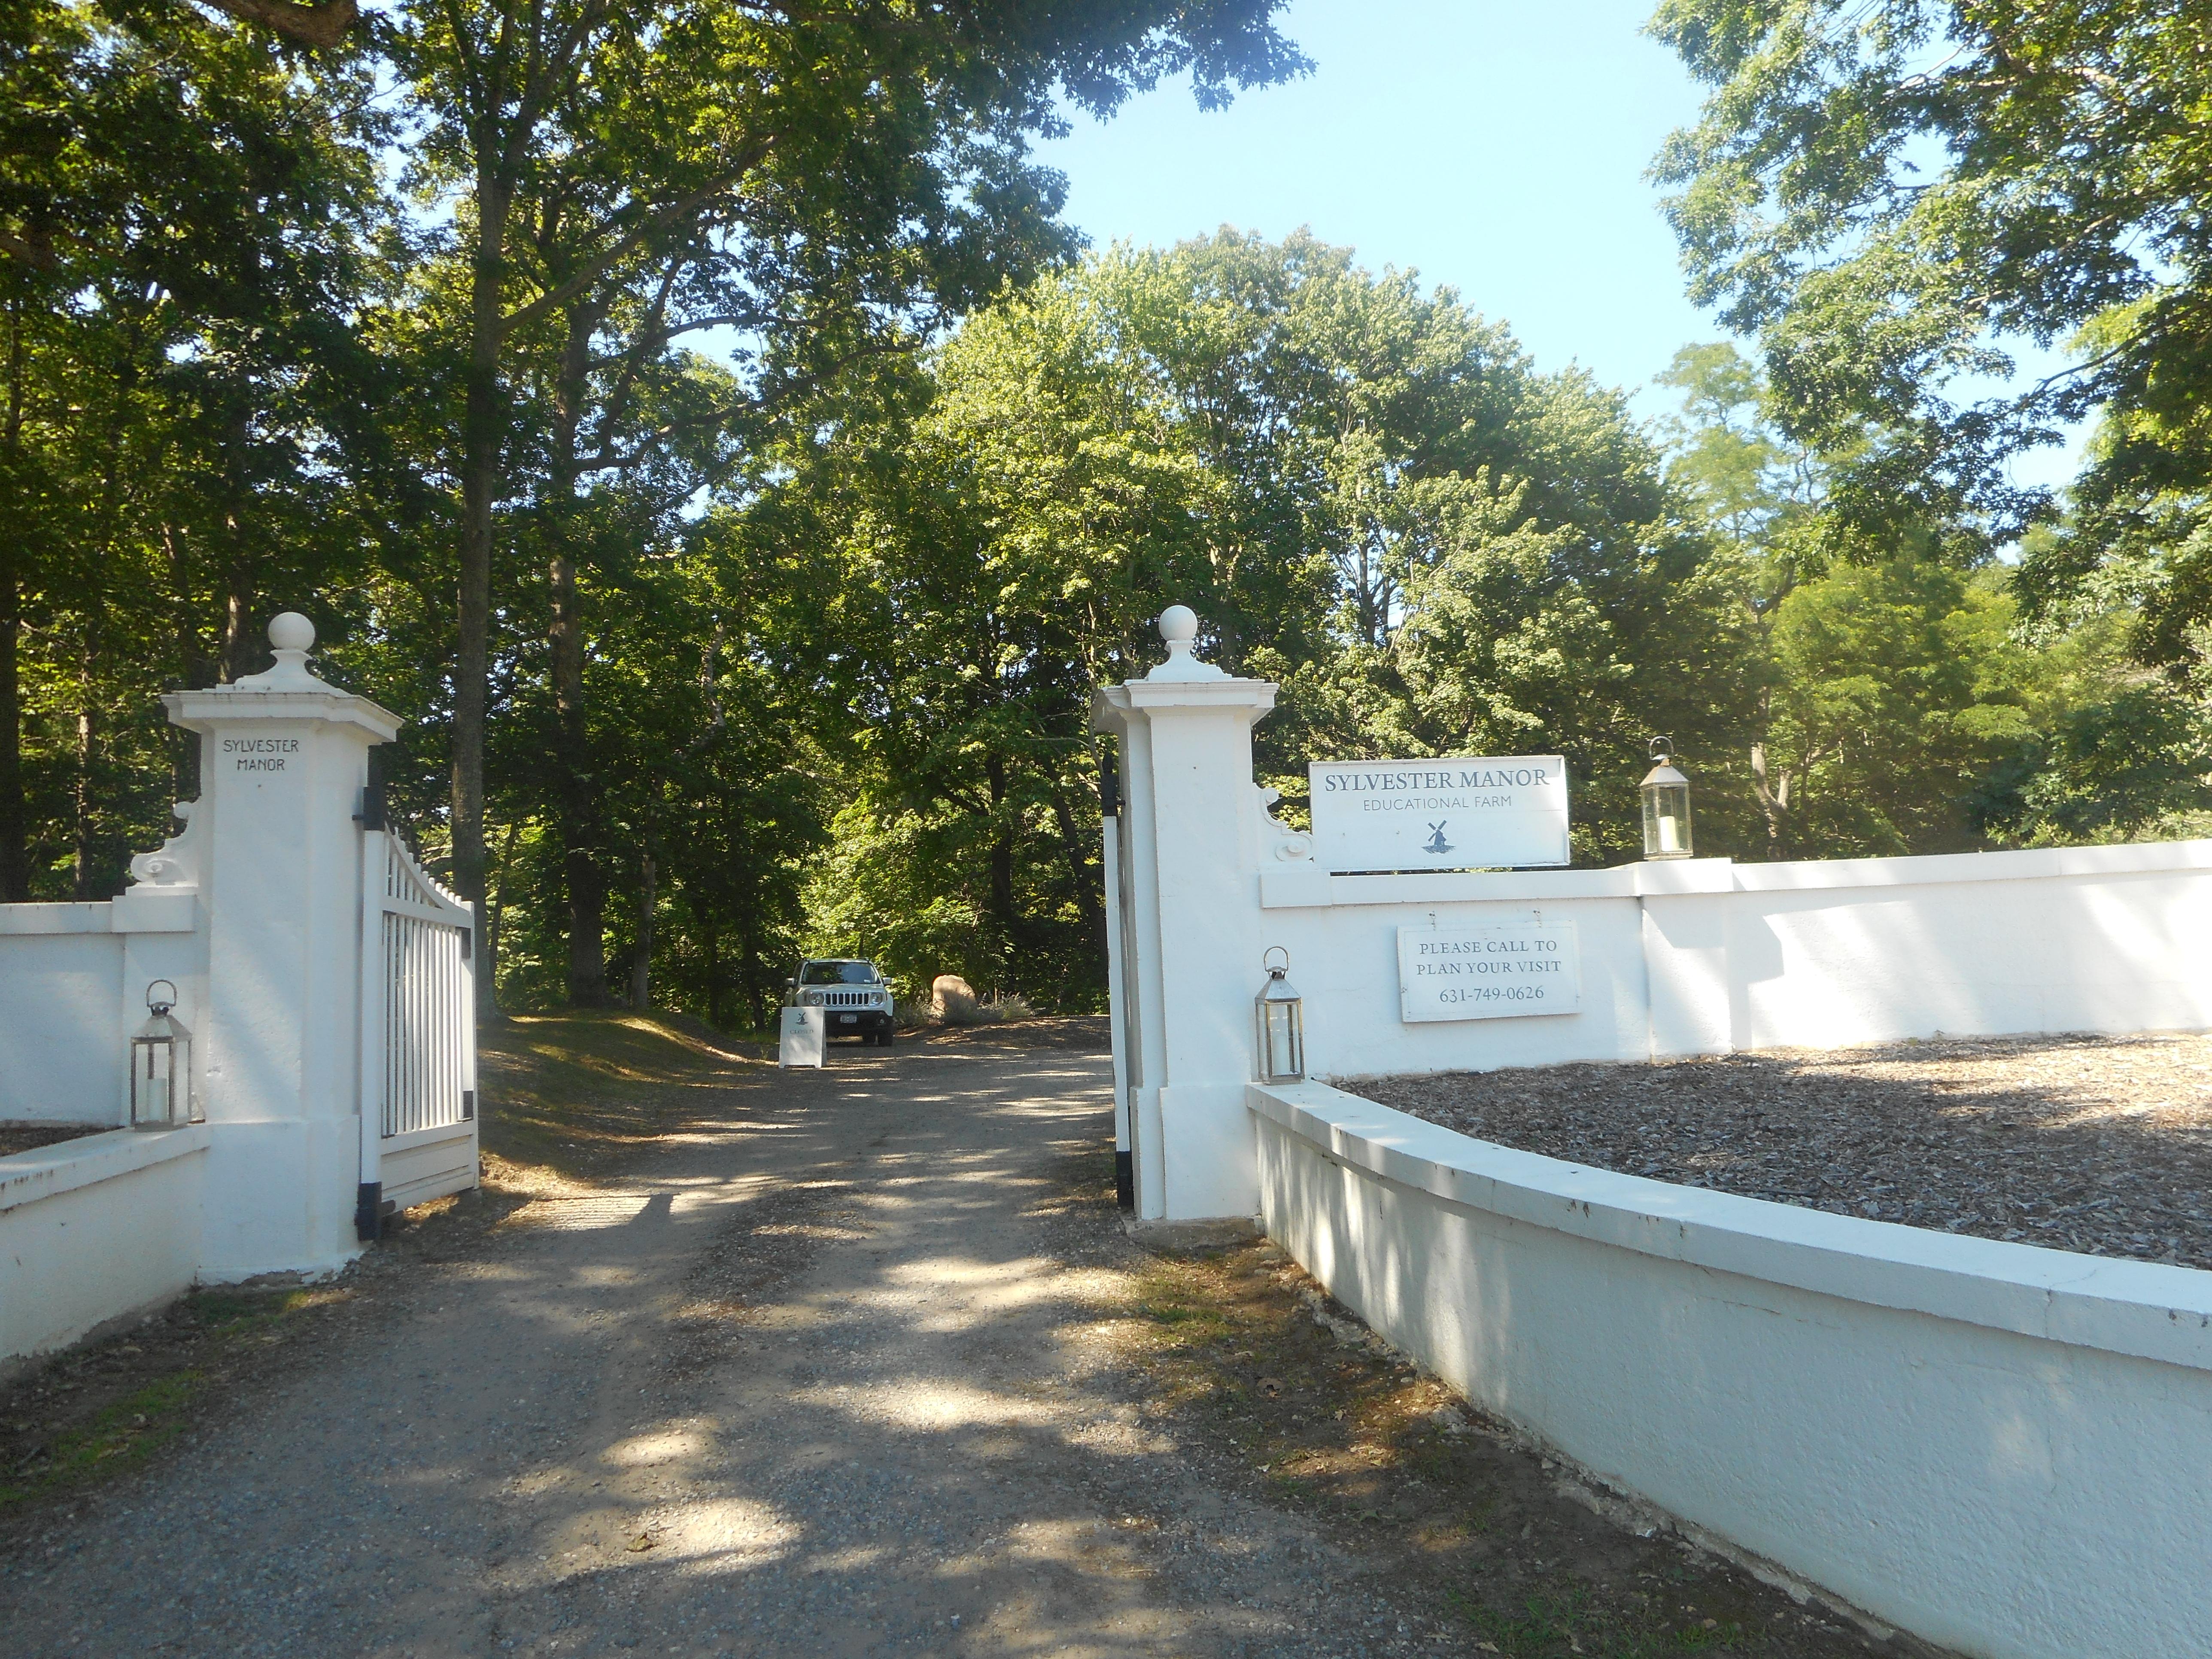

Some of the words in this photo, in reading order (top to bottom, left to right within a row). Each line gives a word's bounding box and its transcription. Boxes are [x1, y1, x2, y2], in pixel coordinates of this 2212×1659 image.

[223, 739, 299, 752] SYLVESTER
[237, 758, 285, 771] MANOR
[1325, 772, 1455, 792] SYLVESTER
[1458, 769, 1550, 787] MANOR
[1364, 797, 1469, 811] EDUCATIONAL
[1475, 796, 1511, 807] FARM
[1419, 942, 1481, 954] PLEASE
[1487, 941, 1529, 952] CALL
[1534, 940, 1557, 951] TO
[1416, 963, 1462, 975] PLAN
[1466, 962, 1513, 973] YOUR
[1516, 960, 1561, 972] VISIT
[1440, 985, 1544, 1003] 631-749-0626
